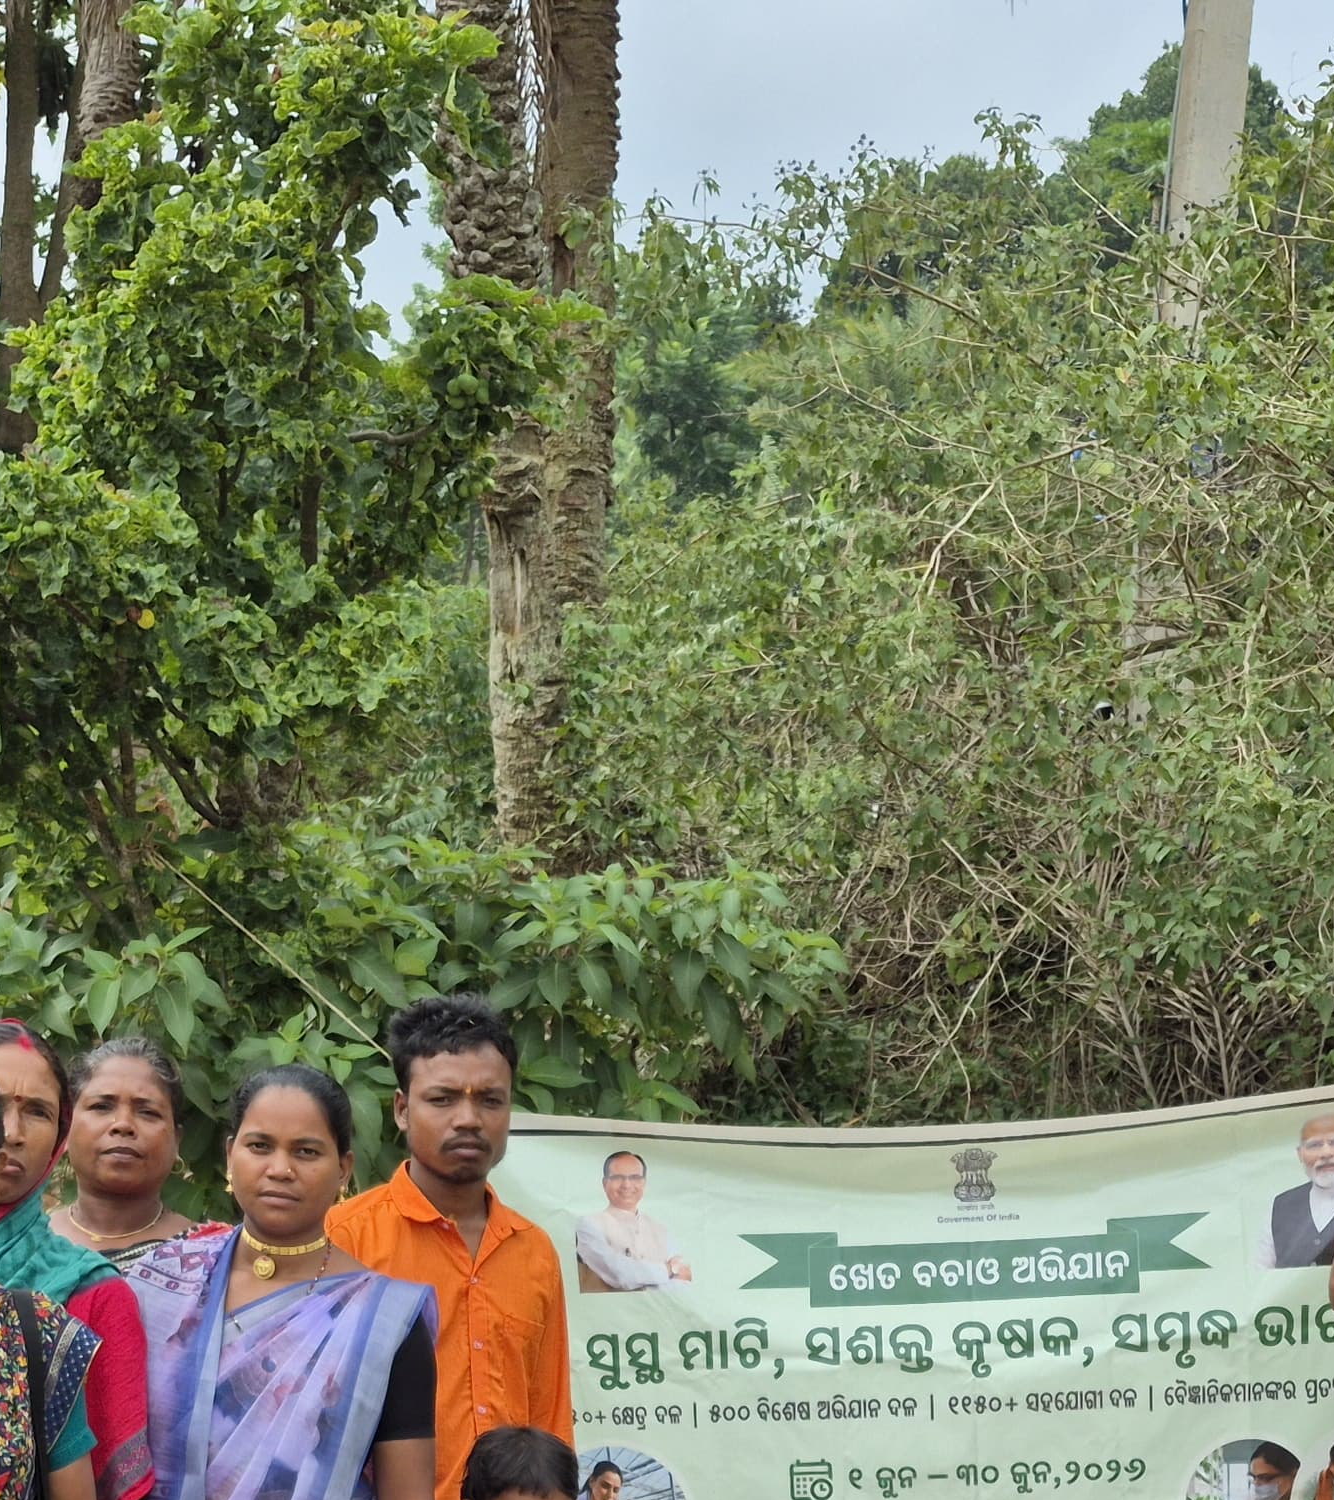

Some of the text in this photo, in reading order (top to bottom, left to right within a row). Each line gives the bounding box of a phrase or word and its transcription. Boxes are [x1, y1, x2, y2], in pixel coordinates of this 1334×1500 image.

[829, 1247, 1130, 1292] ଖେତ ବଚାଓ ଅଭିଯାନ
[586, 1331, 665, 1390] ସୁସ୍ଥ
[678, 1317, 785, 1379] ମାଟି,
[805, 1324, 934, 1374] ସଶକ୍ତ
[951, 1315, 1094, 1378] କୃଷକ,
[1111, 1308, 1238, 1369] ସମୃଦ୍ଧ
[655, 1405, 683, 1425] ଦଳ
[757, 1396, 811, 1421] ବିଶେଷ
[817, 1394, 881, 1419] ଅଭିଯାନ
[888, 1397, 918, 1418] ଦଳ
[1109, 1388, 1137, 1409] ଦଳ
[875, 1466, 917, 1499] ଜୁନ
